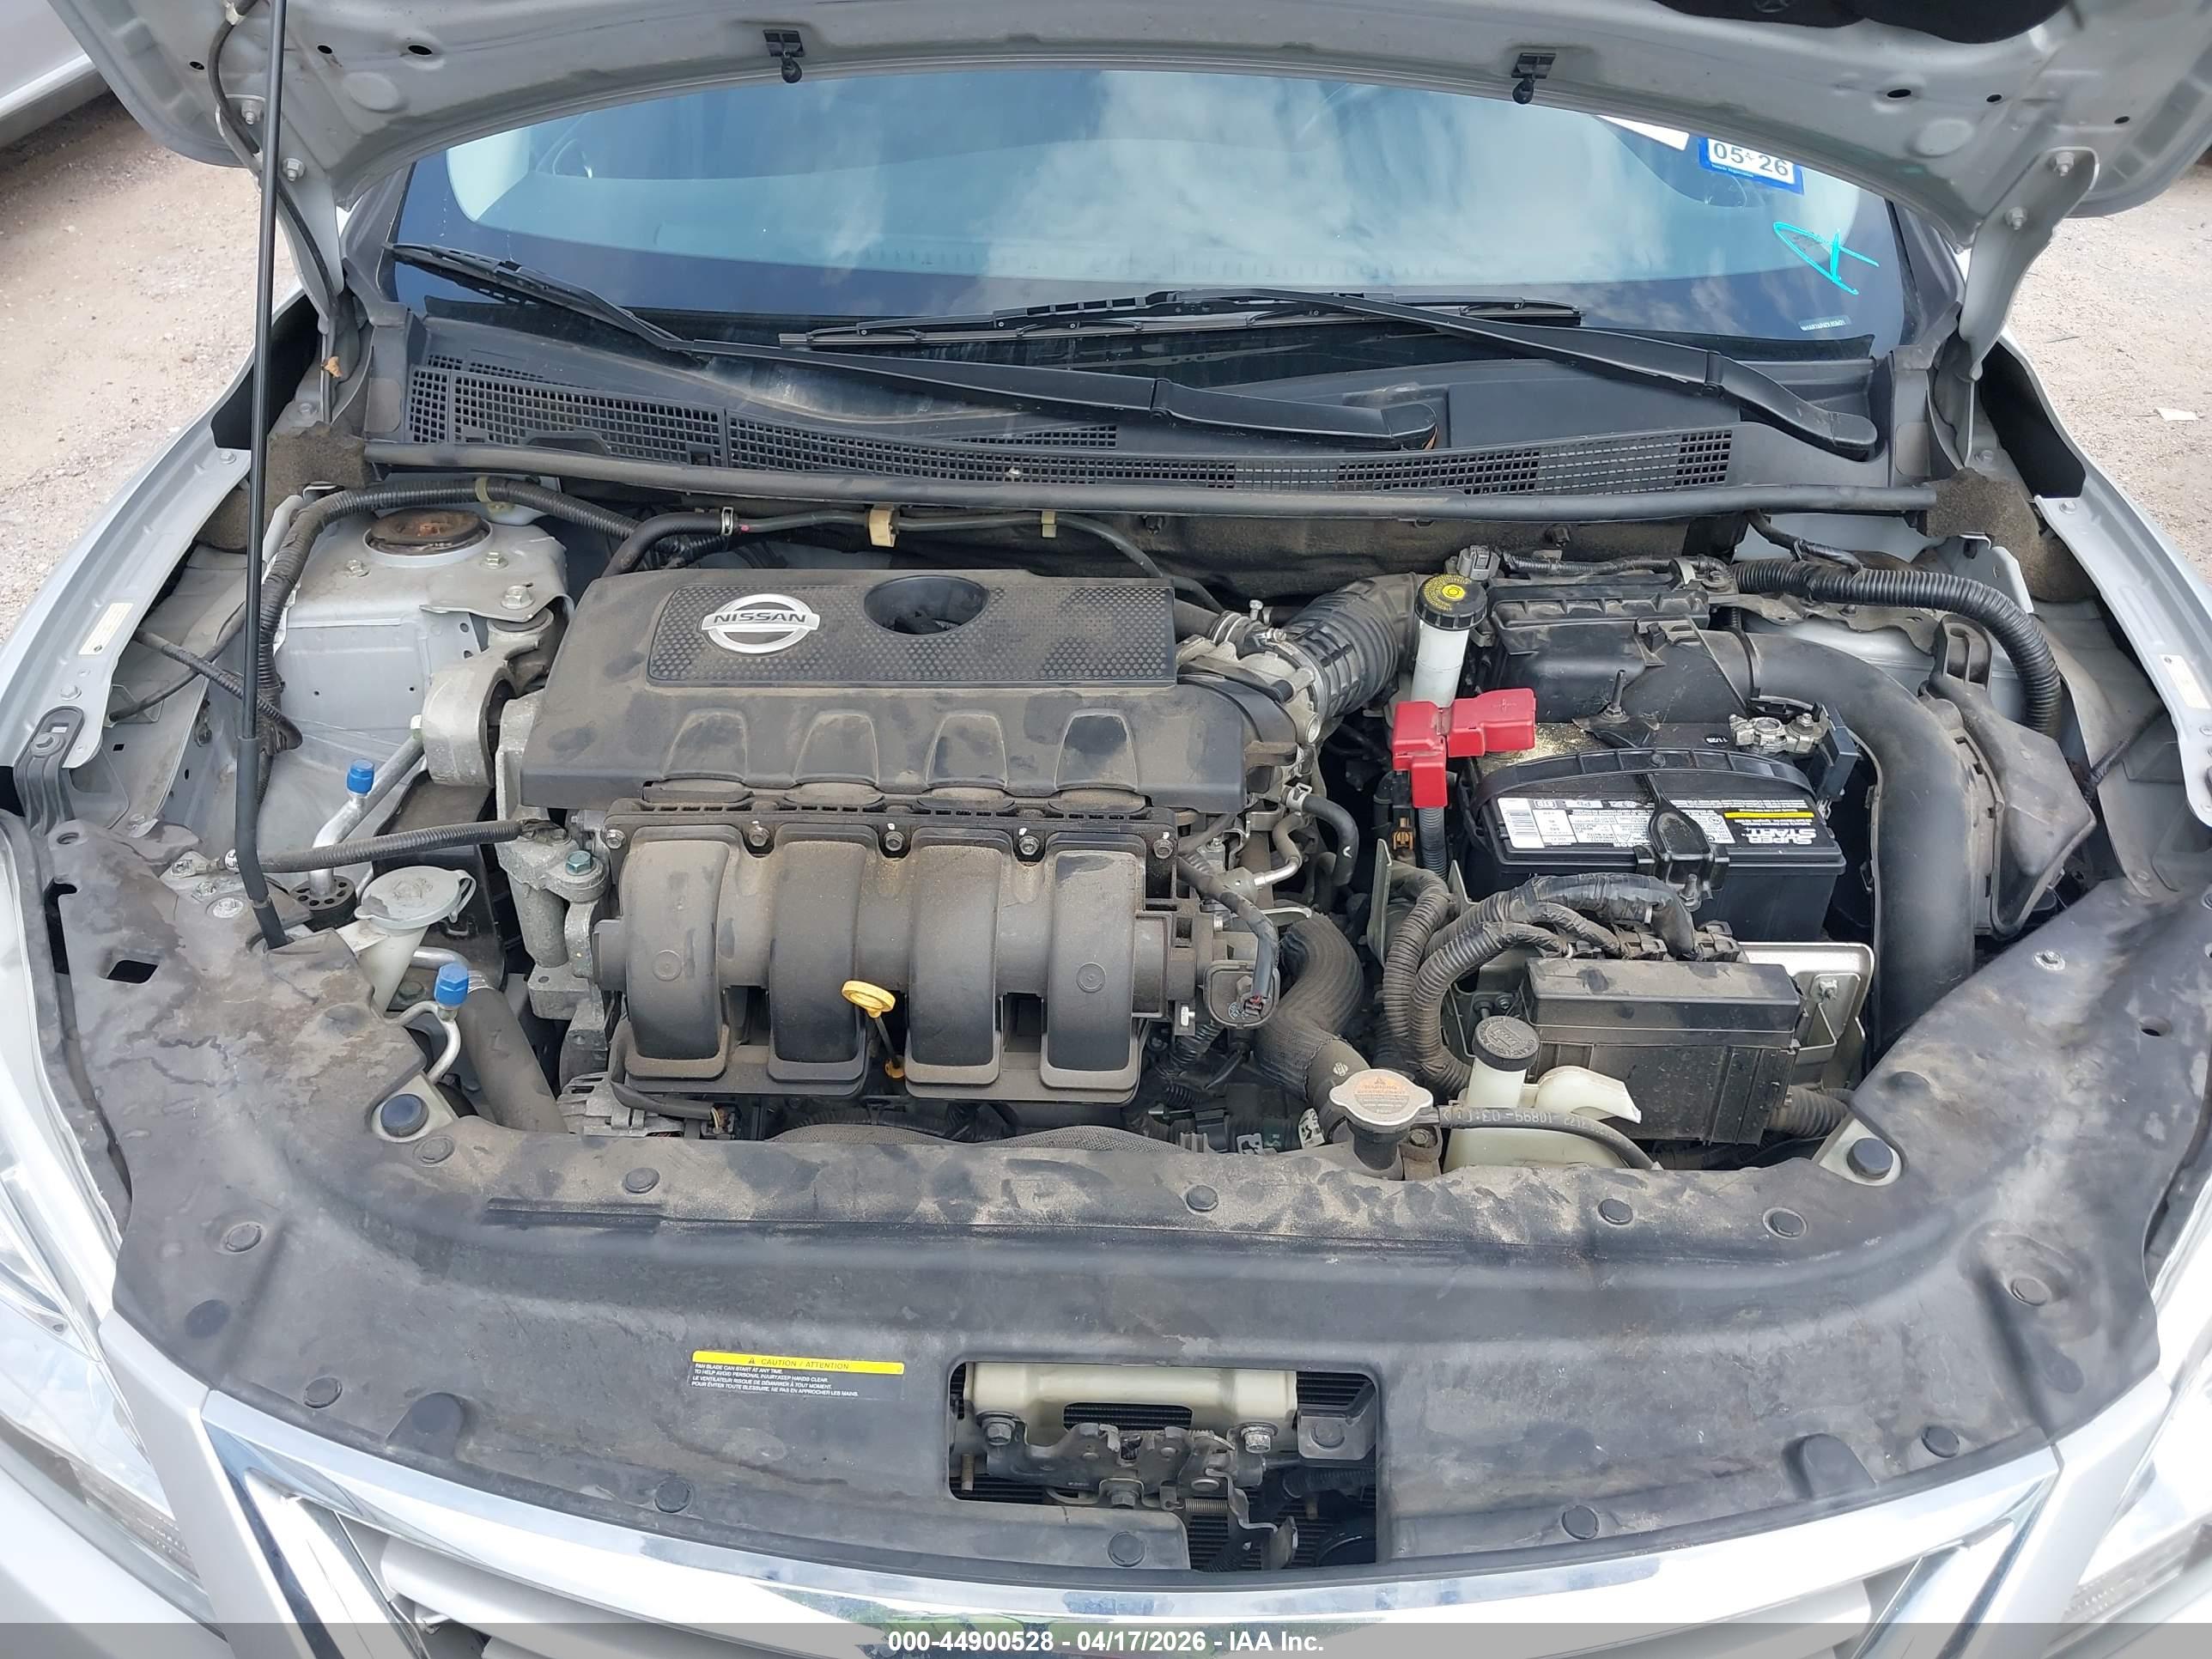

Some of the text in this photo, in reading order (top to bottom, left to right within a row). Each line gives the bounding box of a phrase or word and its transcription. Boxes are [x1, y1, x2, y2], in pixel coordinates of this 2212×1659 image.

[1713, 143, 1744, 164] 05
[1758, 155, 1789, 176] 26
[714, 612, 806, 623] NISSAN
[1746, 829, 1817, 838] START
[1748, 836, 1813, 845] SUPER
[761, 1358, 797, 1367] CAUTION
[805, 1361, 849, 1370] ATTENTION
